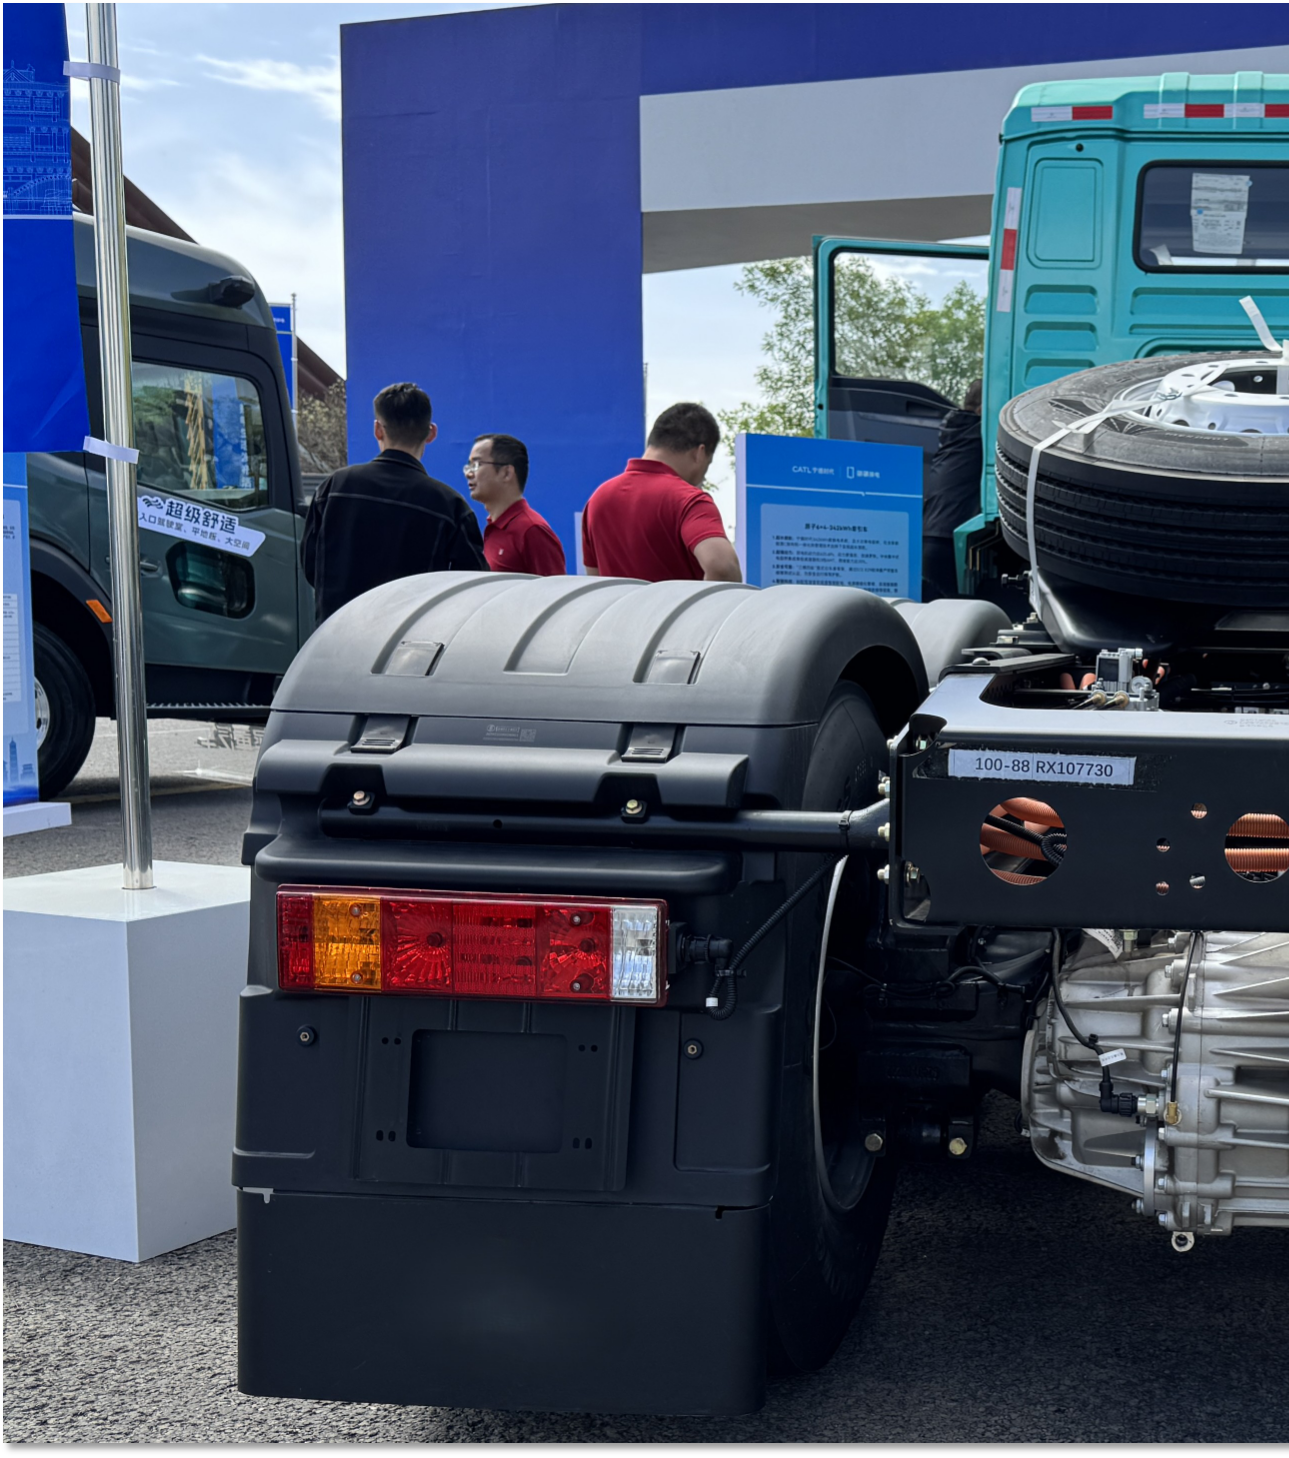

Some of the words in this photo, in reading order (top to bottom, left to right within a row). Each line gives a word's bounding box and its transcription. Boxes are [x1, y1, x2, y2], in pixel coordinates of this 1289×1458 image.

[792, 465, 812, 474] CATL
[166, 500, 237, 535] 超级舒适
[975, 757, 1030, 772] 100-88
[1036, 760, 1113, 777] RX107730
